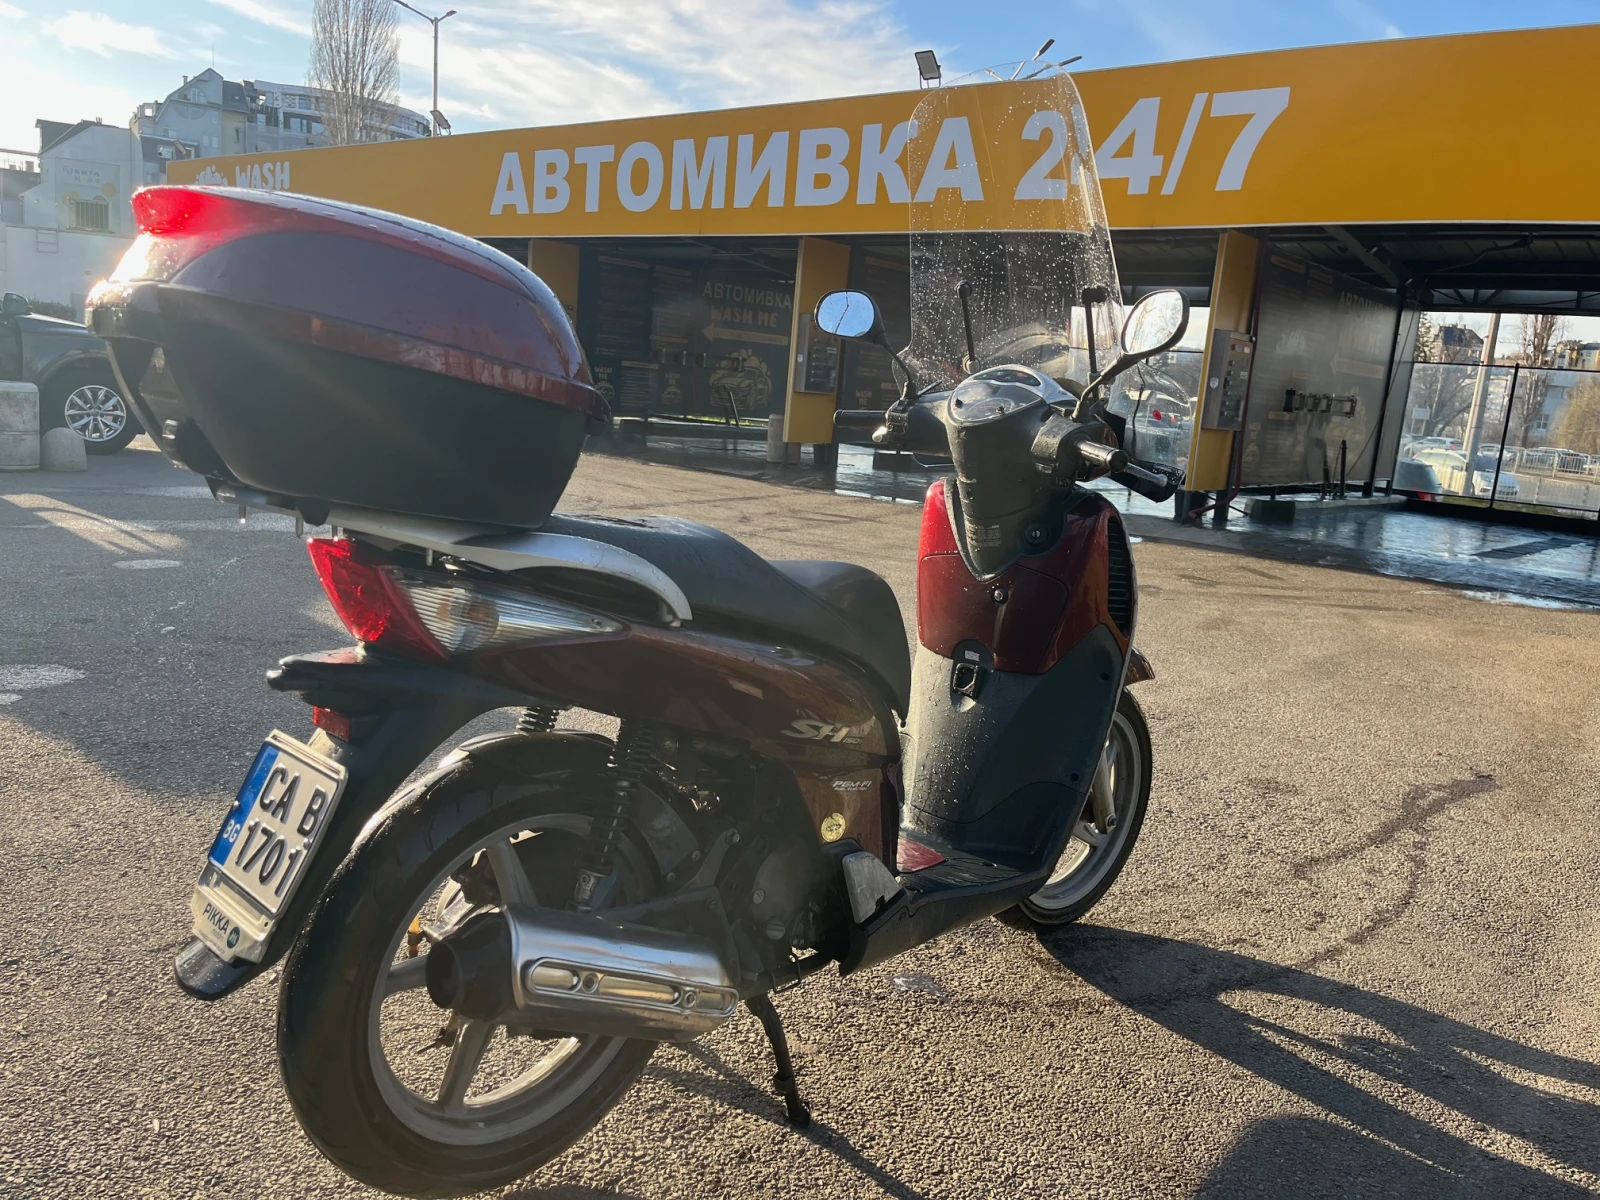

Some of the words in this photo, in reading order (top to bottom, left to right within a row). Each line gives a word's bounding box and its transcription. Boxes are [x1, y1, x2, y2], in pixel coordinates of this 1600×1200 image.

[490, 116, 984, 216] АВТОМИВКА
[1014, 86, 1291, 200] 24/7
[235, 161, 290, 190] WASH
[702, 281, 792, 310] АВТОМИВКА
[711, 304, 753, 324] WASH
[757, 311, 778, 328] ME
[296, 784, 329, 838] B
[223, 819, 241, 843] BG
[234, 818, 303, 897] 1701
[202, 902, 231, 936] PIKKA
